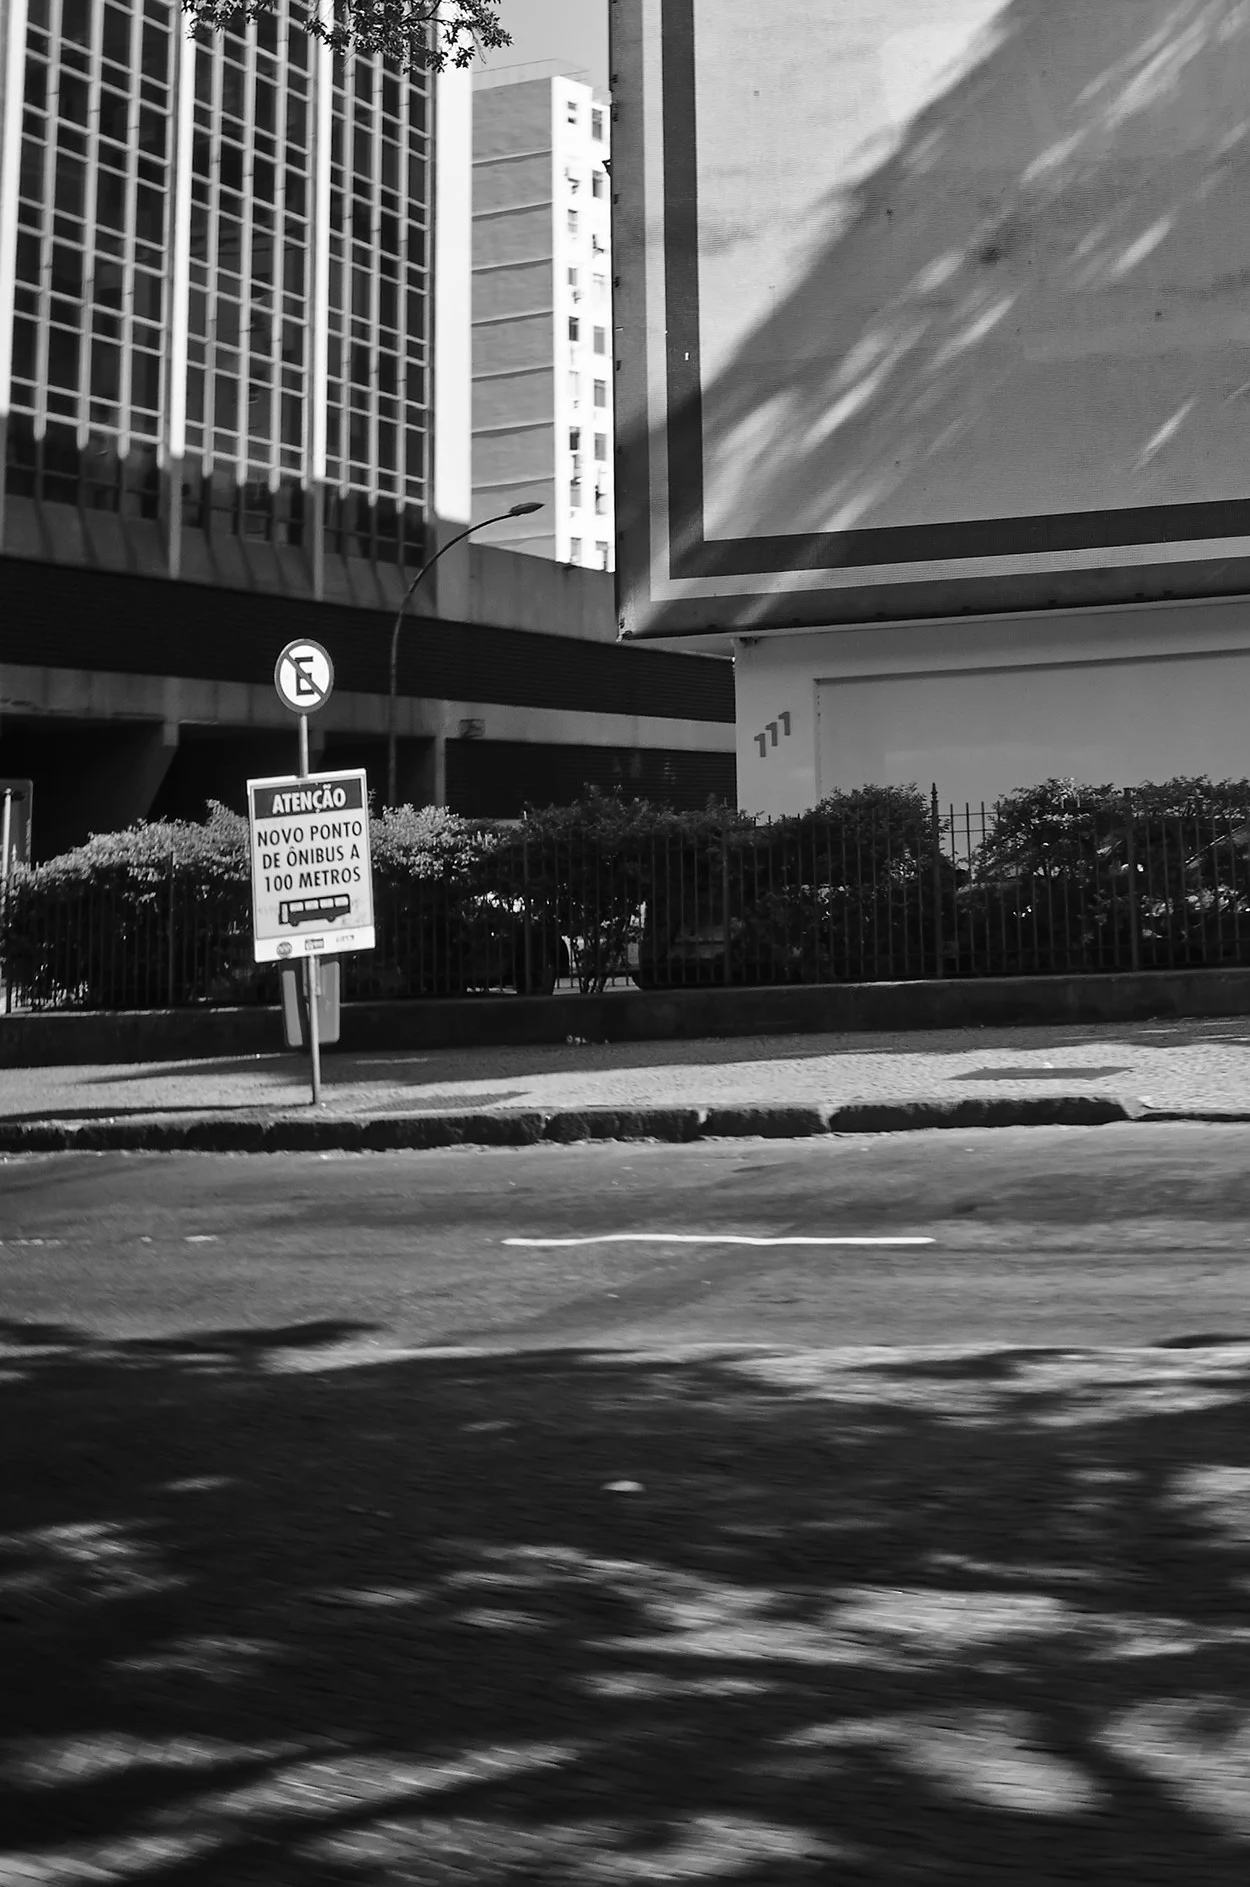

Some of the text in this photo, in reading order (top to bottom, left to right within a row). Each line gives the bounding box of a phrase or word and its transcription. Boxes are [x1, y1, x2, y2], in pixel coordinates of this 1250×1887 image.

[294, 656, 314, 696] E
[272, 784, 347, 814] ATENÇÃO
[257, 820, 363, 848] NOVO PONTO
[262, 843, 360, 870] DE ÔNIBUS A
[264, 866, 361, 893] 100 METROS
